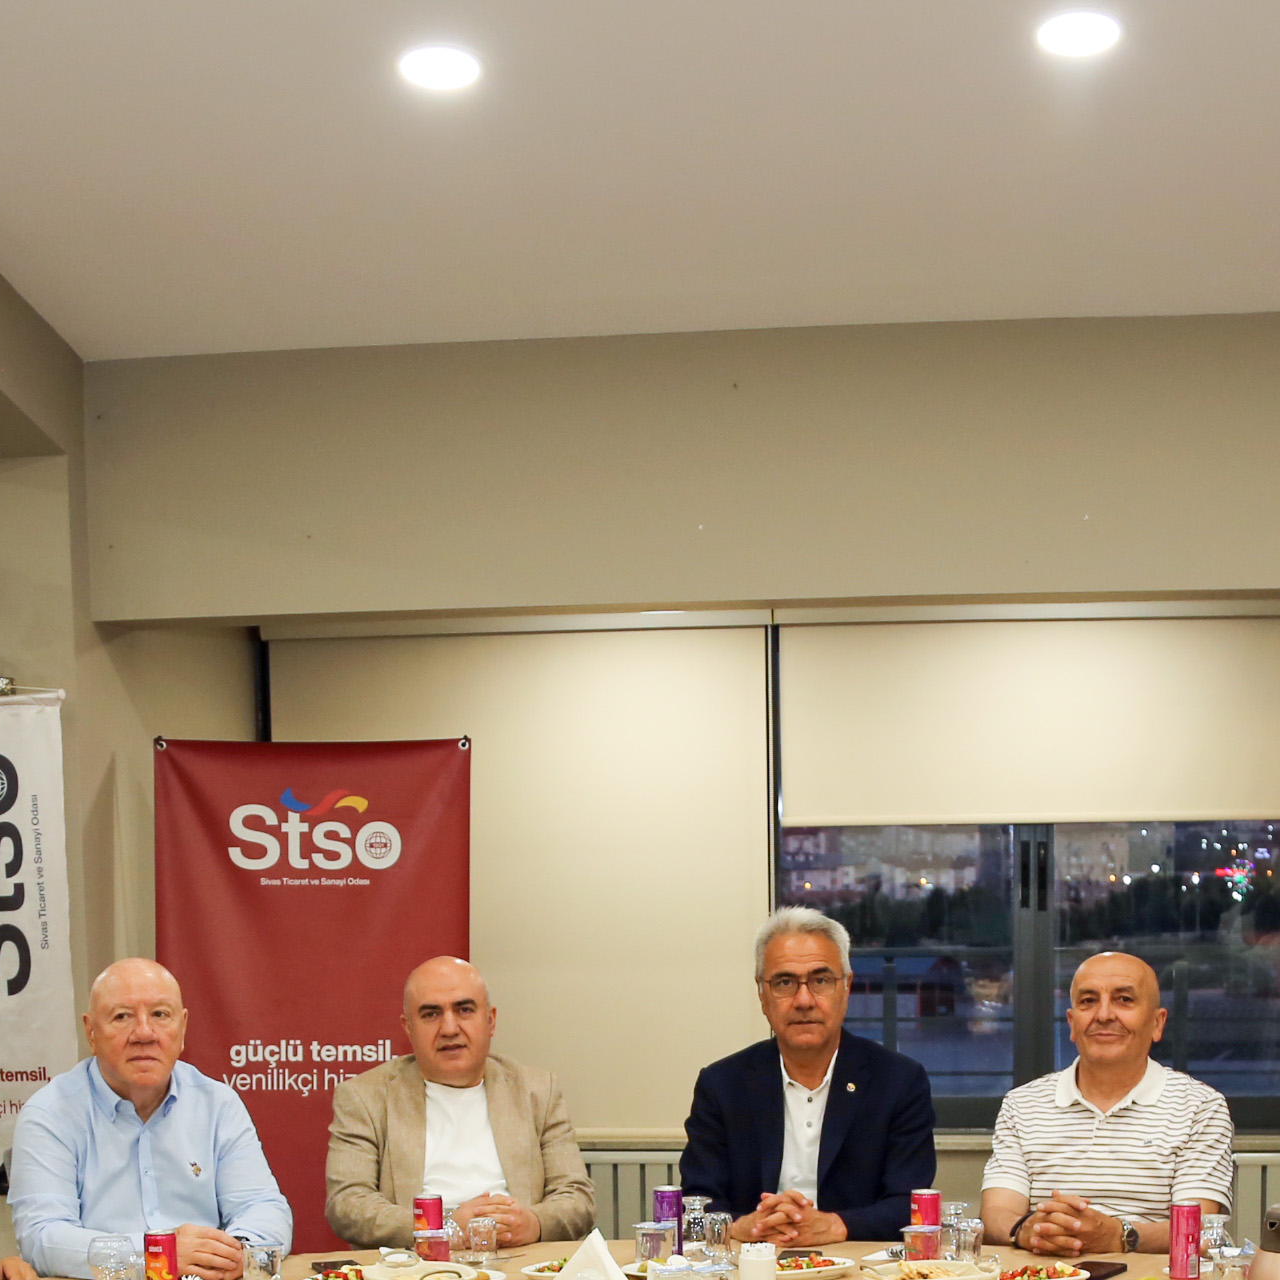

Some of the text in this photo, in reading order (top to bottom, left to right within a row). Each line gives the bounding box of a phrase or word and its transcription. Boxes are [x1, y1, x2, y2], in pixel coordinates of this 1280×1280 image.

[228, 803, 402, 870] Stso
[31, 794, 49, 950] Sivas Ticaret ve Sanayi Odası
[260, 877, 281, 886] Sivas
[282, 877, 309, 886] Ticaret
[321, 877, 347, 887] Sanayi
[347, 877, 370, 886] Odası
[230, 1039, 303, 1068] güçlü
[0, 1066, 51, 1083] temsil,
